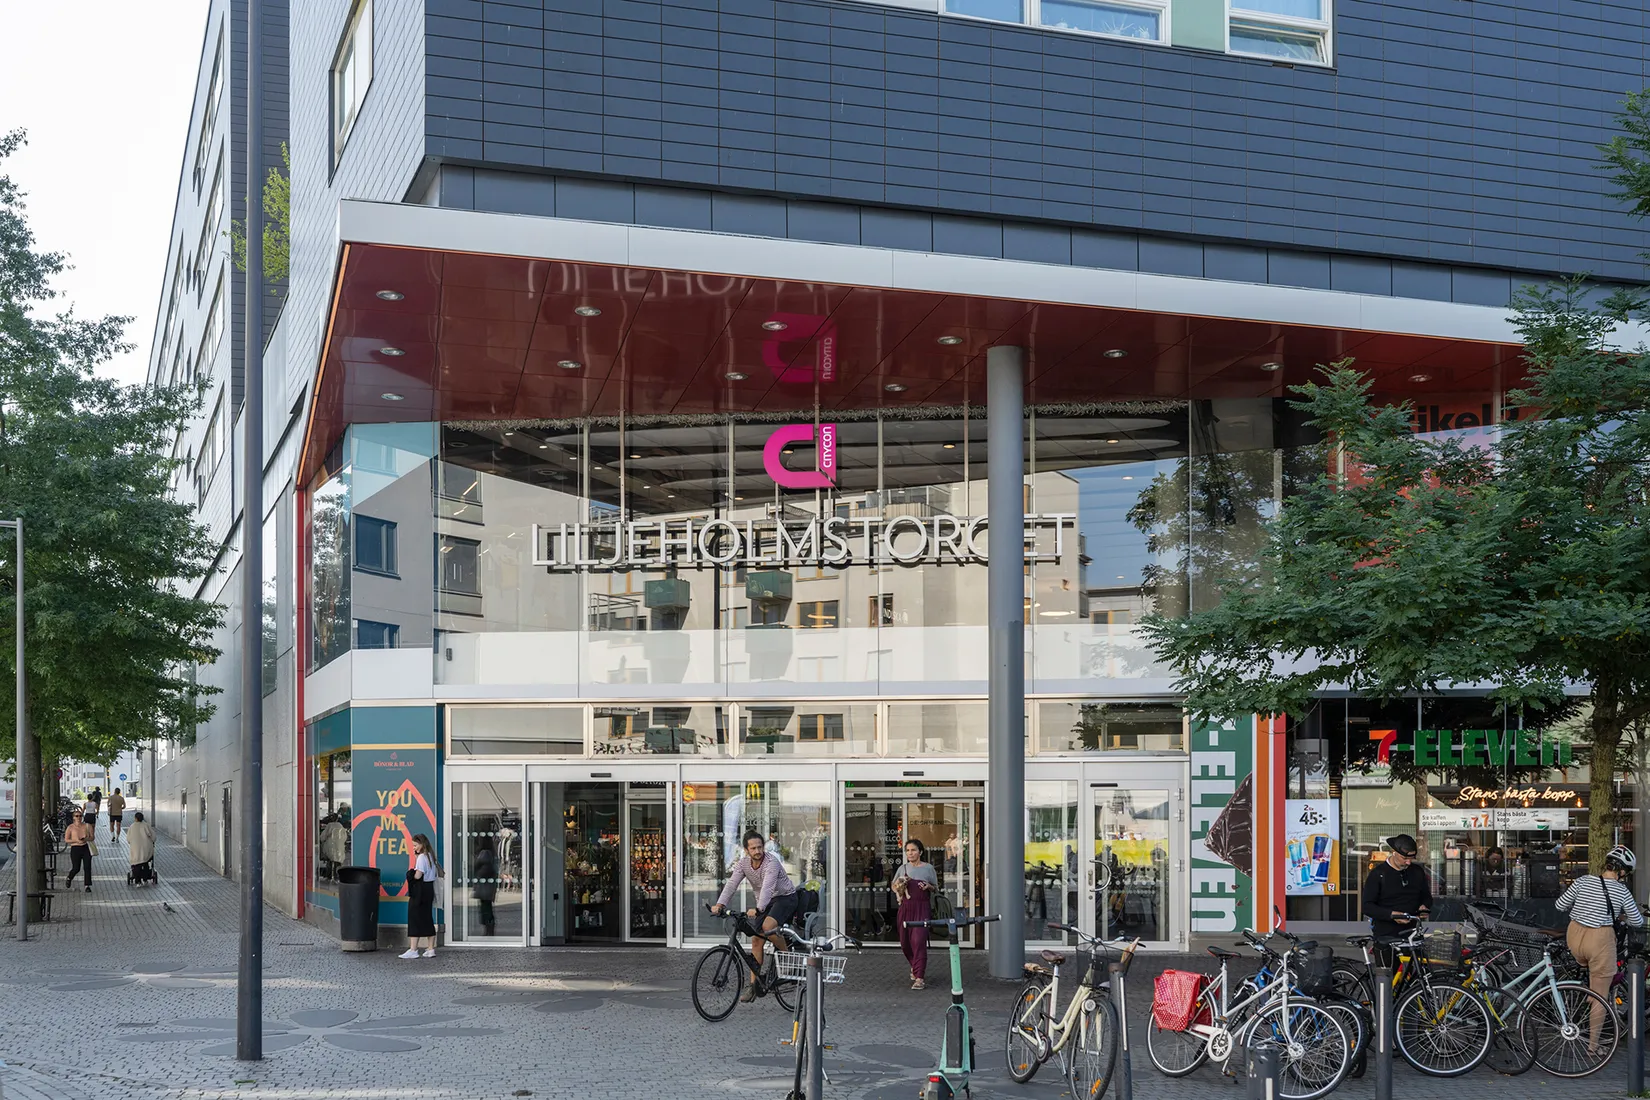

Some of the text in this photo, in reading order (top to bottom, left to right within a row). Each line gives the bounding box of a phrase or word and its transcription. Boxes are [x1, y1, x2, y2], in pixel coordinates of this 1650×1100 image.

[822, 426, 832, 468] CITYCON
[376, 790, 412, 808] YOU
[1459, 785, 1498, 801] Stans
[1541, 785, 1576, 801] kopp
[380, 814, 407, 832] ME
[1299, 811, 1327, 826] 45:-
[377, 838, 409, 855] TEA
